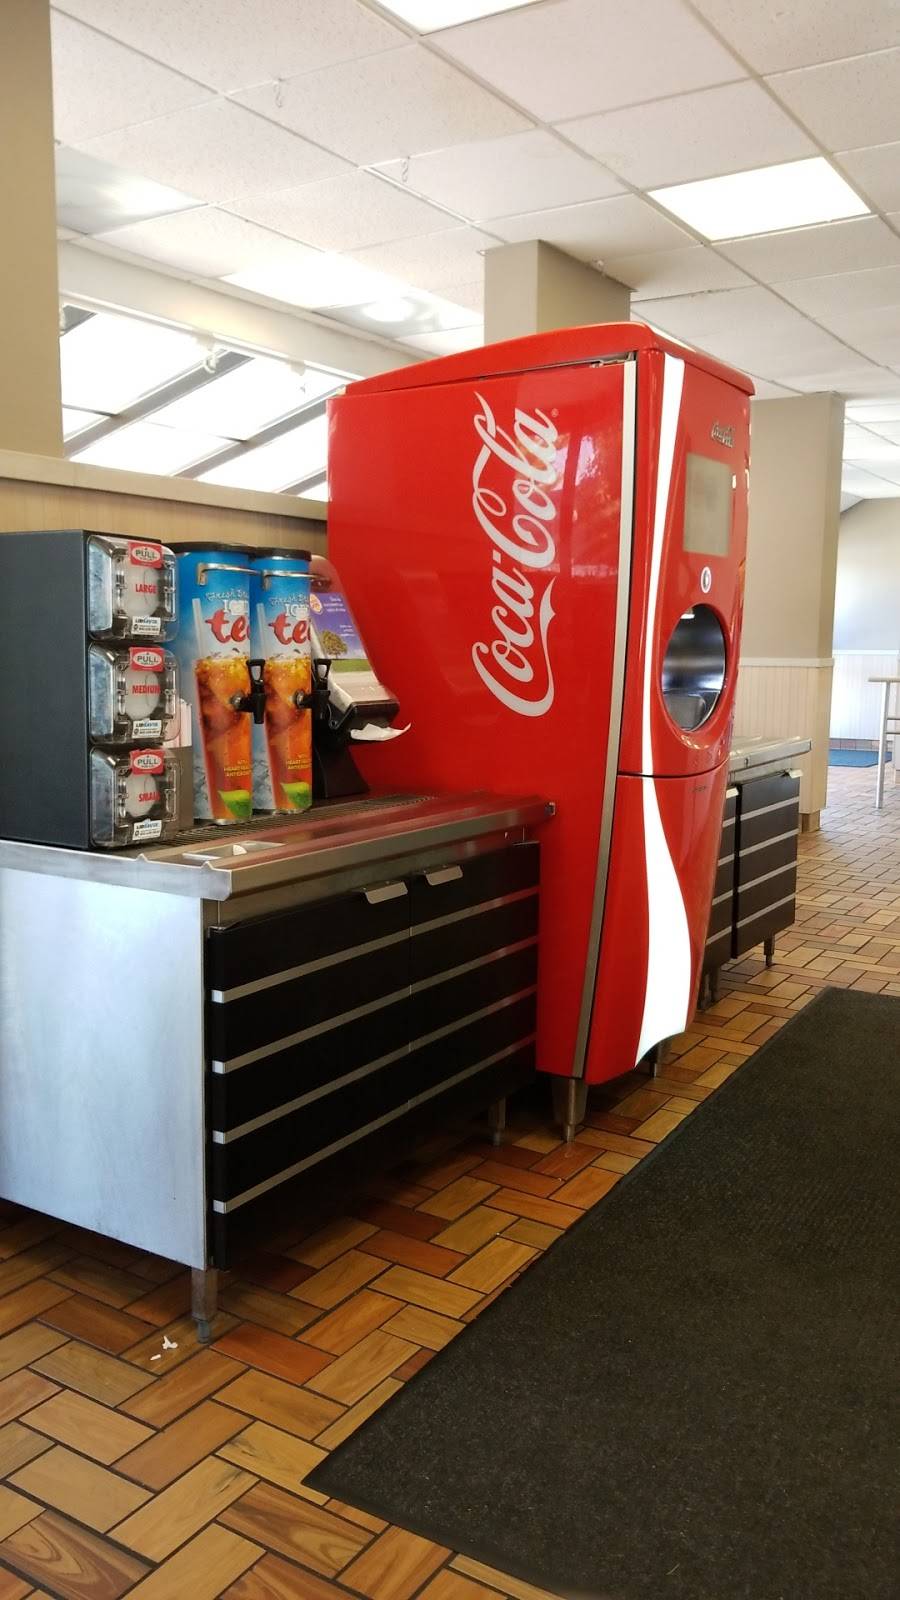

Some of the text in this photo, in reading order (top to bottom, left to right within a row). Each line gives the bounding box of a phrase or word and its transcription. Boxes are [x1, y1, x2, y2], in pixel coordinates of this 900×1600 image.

[135, 549, 156, 557] PULL
[472, 391, 558, 717] Coca-Cola
[135, 583, 157, 594] LARGE
[205, 610, 250, 643] te
[268, 612, 311, 645] te
[137, 655, 159, 663] PULL
[132, 684, 161, 695] MEDIUM
[137, 758, 159, 766] PULL
[138, 791, 161, 802] SMALL
